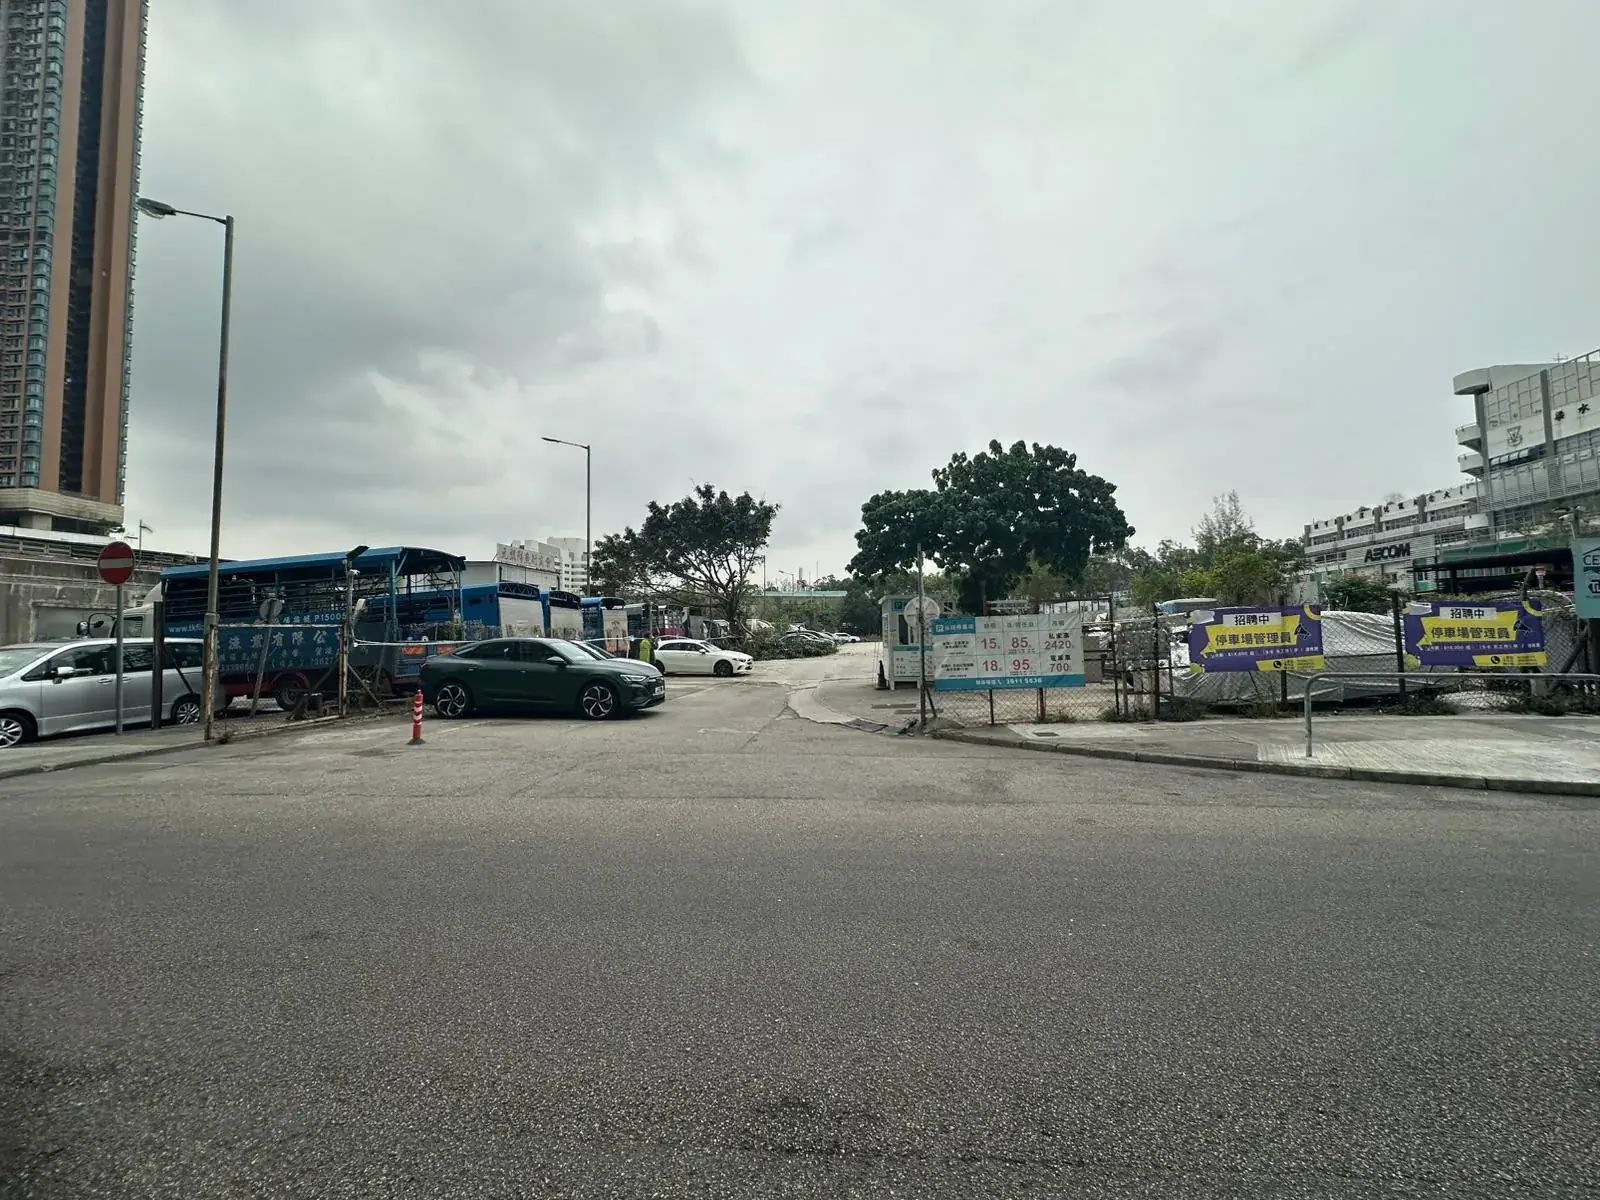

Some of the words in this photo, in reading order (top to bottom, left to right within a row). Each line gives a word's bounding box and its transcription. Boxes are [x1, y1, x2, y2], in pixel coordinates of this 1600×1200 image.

[1364, 543, 1411, 563] AECOM
[1450, 608, 1485, 619] 招聘中
[1234, 614, 1270, 626] 招聘中
[1216, 632, 1291, 645] 停車場管理員
[1431, 627, 1510, 640] 停車場管理員
[981, 637, 997, 649] 15
[1011, 636, 1029, 649] 85
[1044, 640, 1072, 650] 2420
[983, 659, 999, 672] 18
[1012, 659, 1030, 671] 95
[1049, 662, 1070, 673] 700
